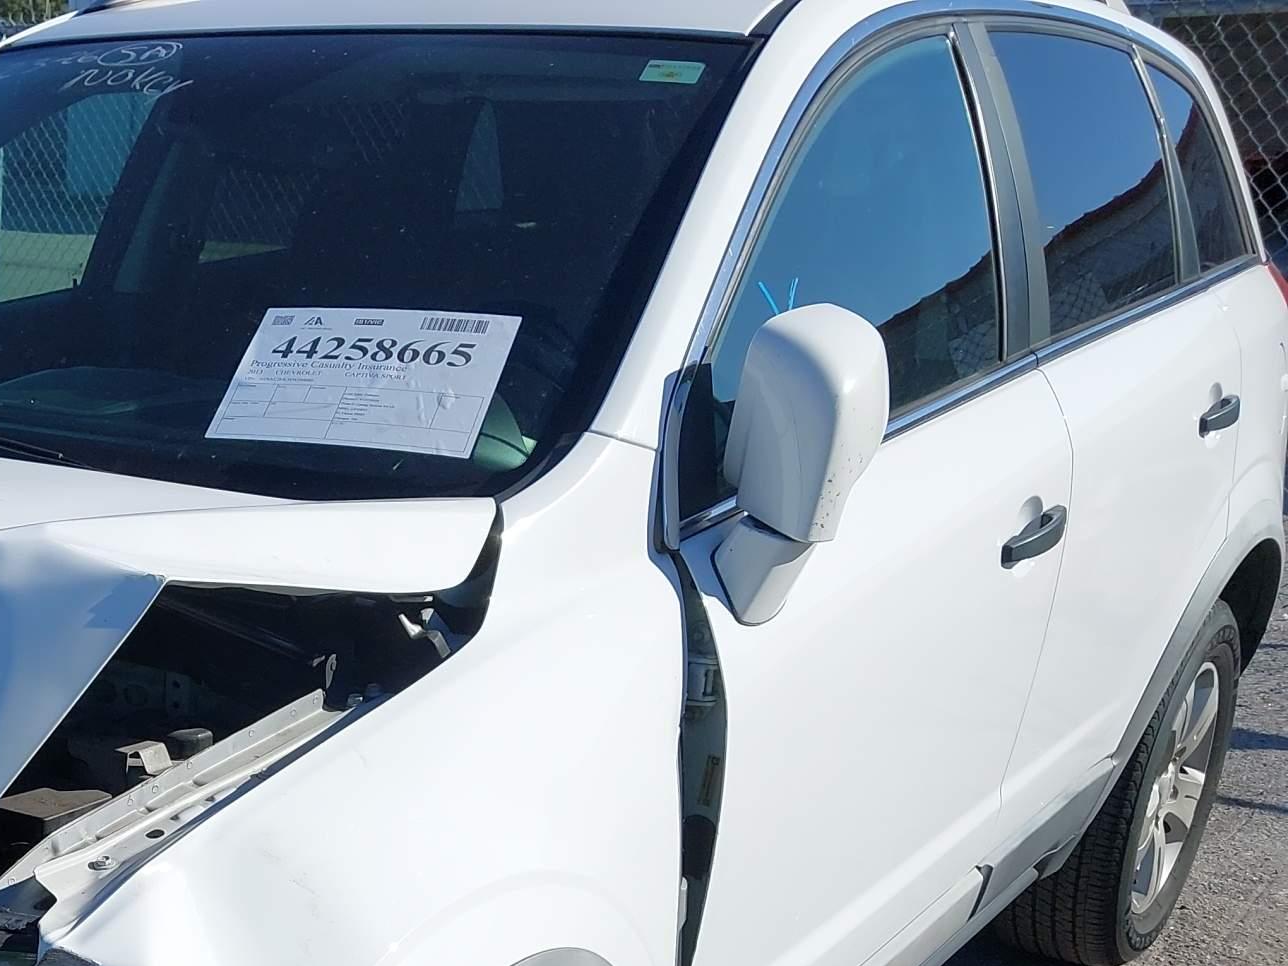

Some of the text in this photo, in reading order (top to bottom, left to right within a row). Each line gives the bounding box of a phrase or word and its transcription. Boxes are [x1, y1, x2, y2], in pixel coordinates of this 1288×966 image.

[271, 335, 477, 367] 44258665
[250, 358, 408, 373] Progressive Casualty Insurance
